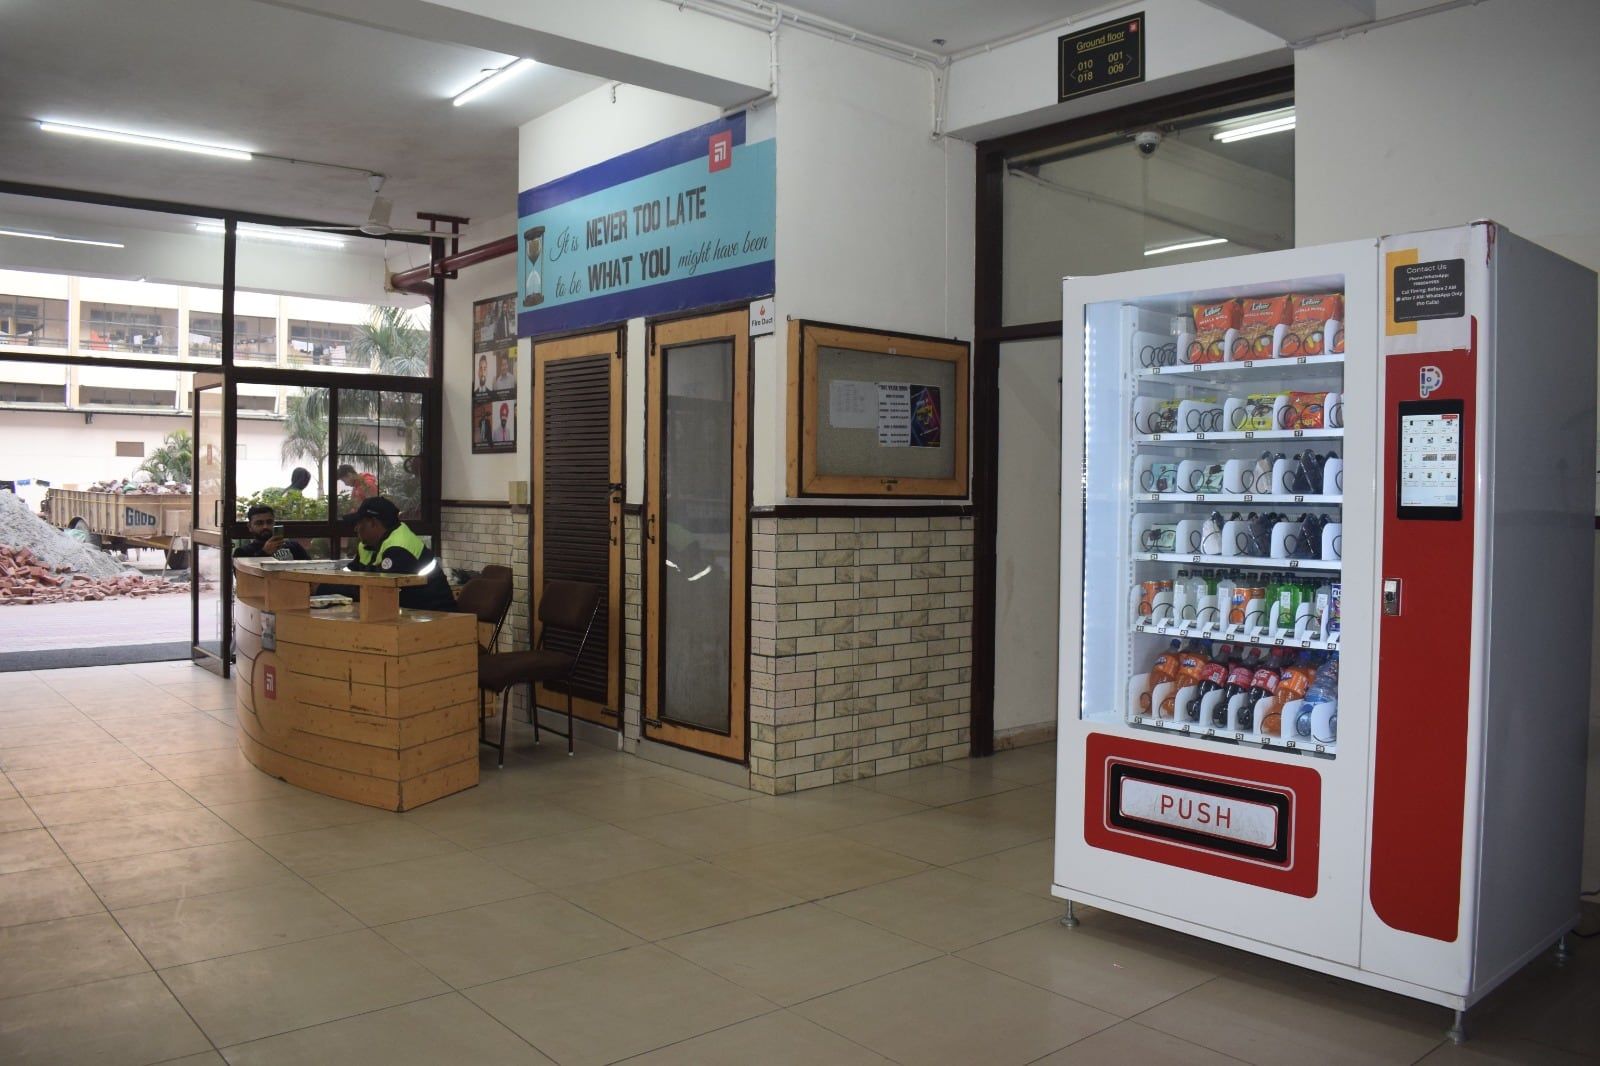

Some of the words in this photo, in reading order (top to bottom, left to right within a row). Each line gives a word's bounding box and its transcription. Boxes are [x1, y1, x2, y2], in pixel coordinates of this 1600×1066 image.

[1076, 34, 1105, 50] Ground
[1107, 31, 1125, 42] floor
[1108, 51, 1123, 62] 001
[1077, 59, 1093, 71] 010
[1108, 63, 1124, 75] 009
[1077, 71, 1093, 83] 018
[550, 226, 570, 262] It
[570, 235, 579, 252] is
[586, 209, 628, 251] NEVER
[633, 199, 661, 236] TOO
[666, 185, 707, 227] LATE
[555, 275, 566, 298] to
[569, 271, 582, 295] be
[588, 255, 633, 292] WHAT
[640, 246, 670, 281] YOU
[678, 239, 711, 275] might
[713, 237, 739, 262] have
[743, 230, 769, 254] been
[1406, 265, 1436, 274] Contact
[1437, 263, 1447, 271] Us
[751, 319, 761, 327] Fire
[761, 317, 773, 326] Duct
[125, 506, 156, 526] GOOD
[1160, 794, 1232, 829] PUSH
